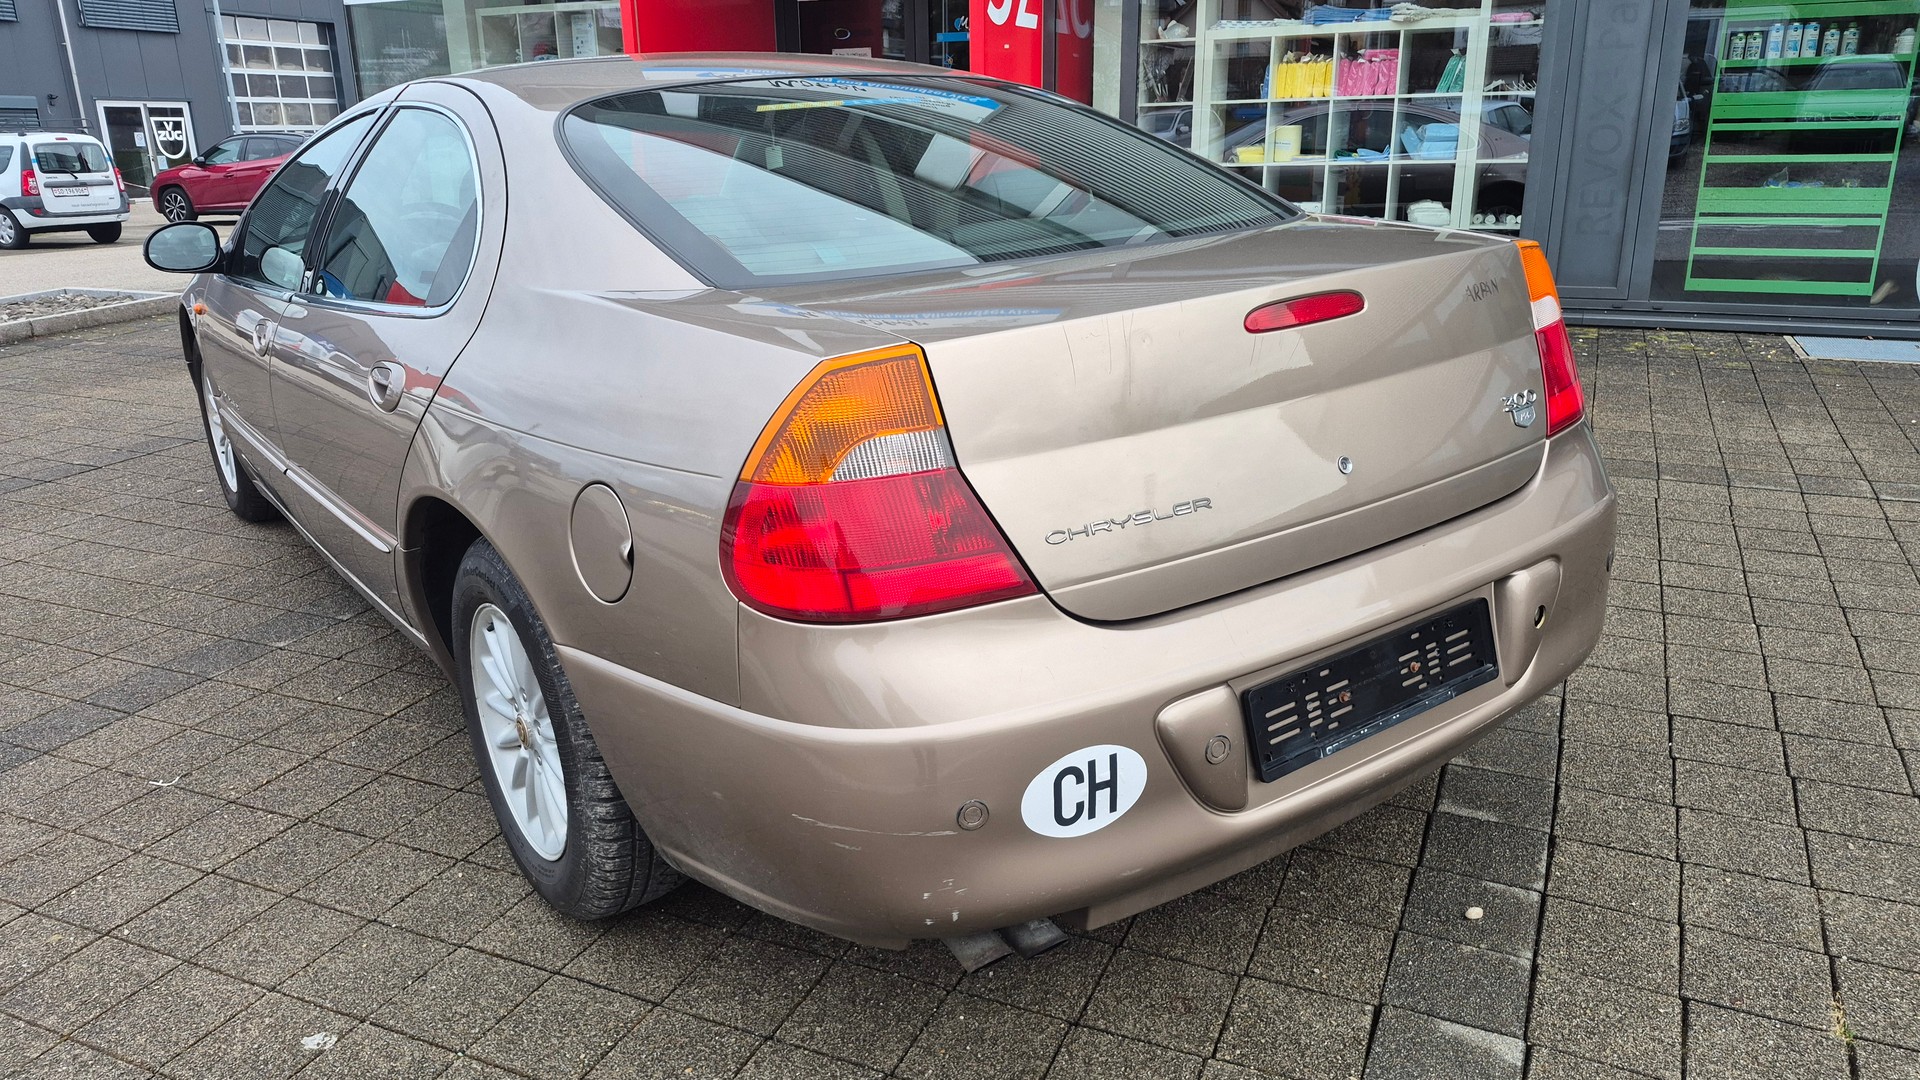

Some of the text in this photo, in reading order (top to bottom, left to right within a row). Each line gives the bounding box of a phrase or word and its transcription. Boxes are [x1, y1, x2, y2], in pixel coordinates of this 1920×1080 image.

[157, 130, 183, 142] ZUG
[163, 121, 174, 131] V
[1045, 497, 1212, 545] CHRYSLER
[1053, 752, 1118, 827] CH
